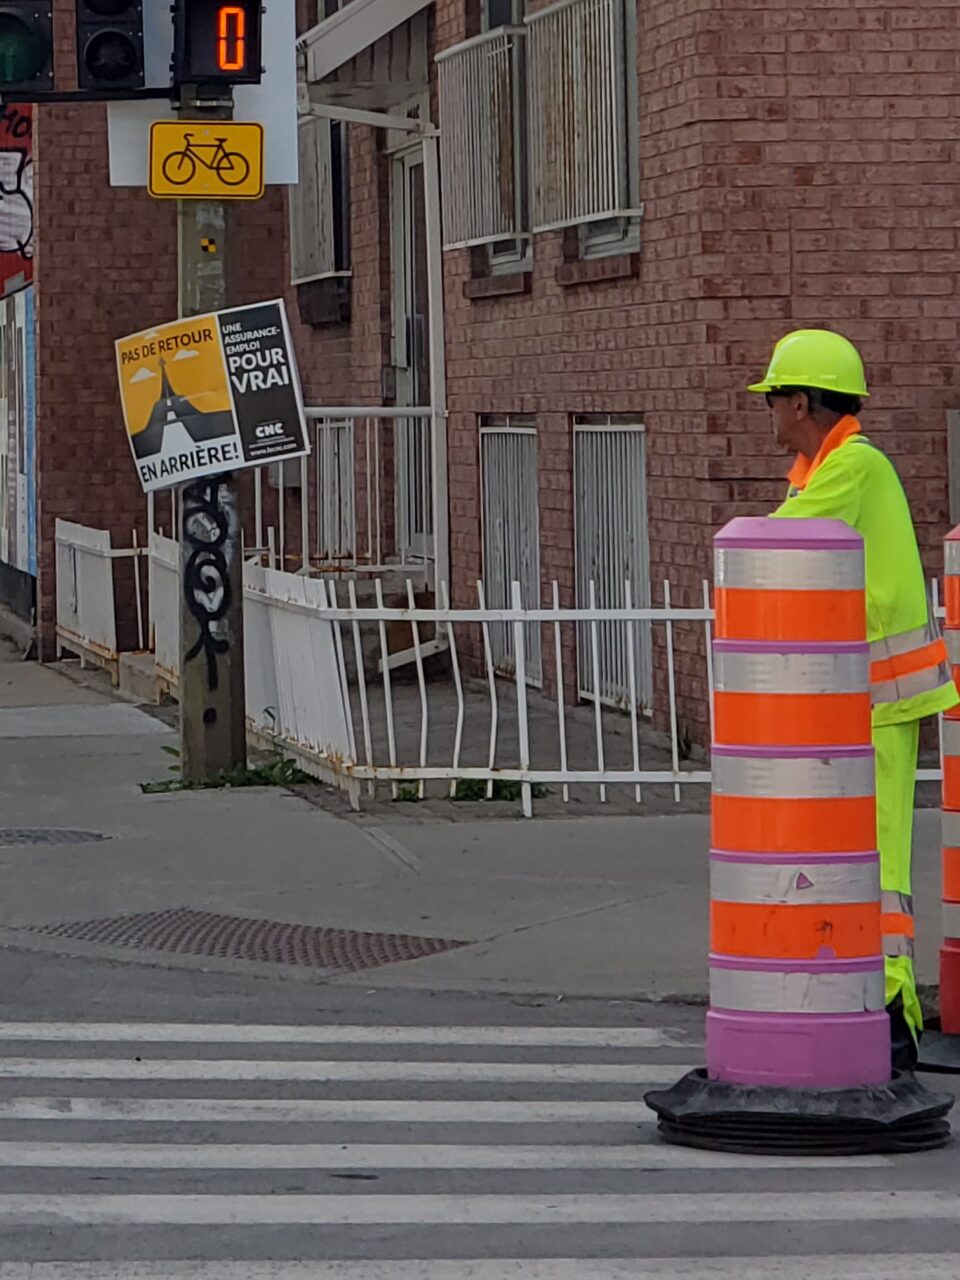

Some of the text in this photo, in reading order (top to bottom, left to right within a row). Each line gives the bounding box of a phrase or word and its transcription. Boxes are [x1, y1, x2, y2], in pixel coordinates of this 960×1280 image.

[221, 321, 242, 334] UNE
[223, 325, 281, 345] ASSURANCE-
[121, 327, 214, 365] PAS DE RETOUR
[225, 340, 261, 356] EMPLOI
[228, 347, 286, 373] POUR
[231, 365, 290, 394] VRAI
[255, 422, 284, 438] CNC
[140, 463, 159, 484] EN
[159, 441, 240, 479] ARRIÈRE!
